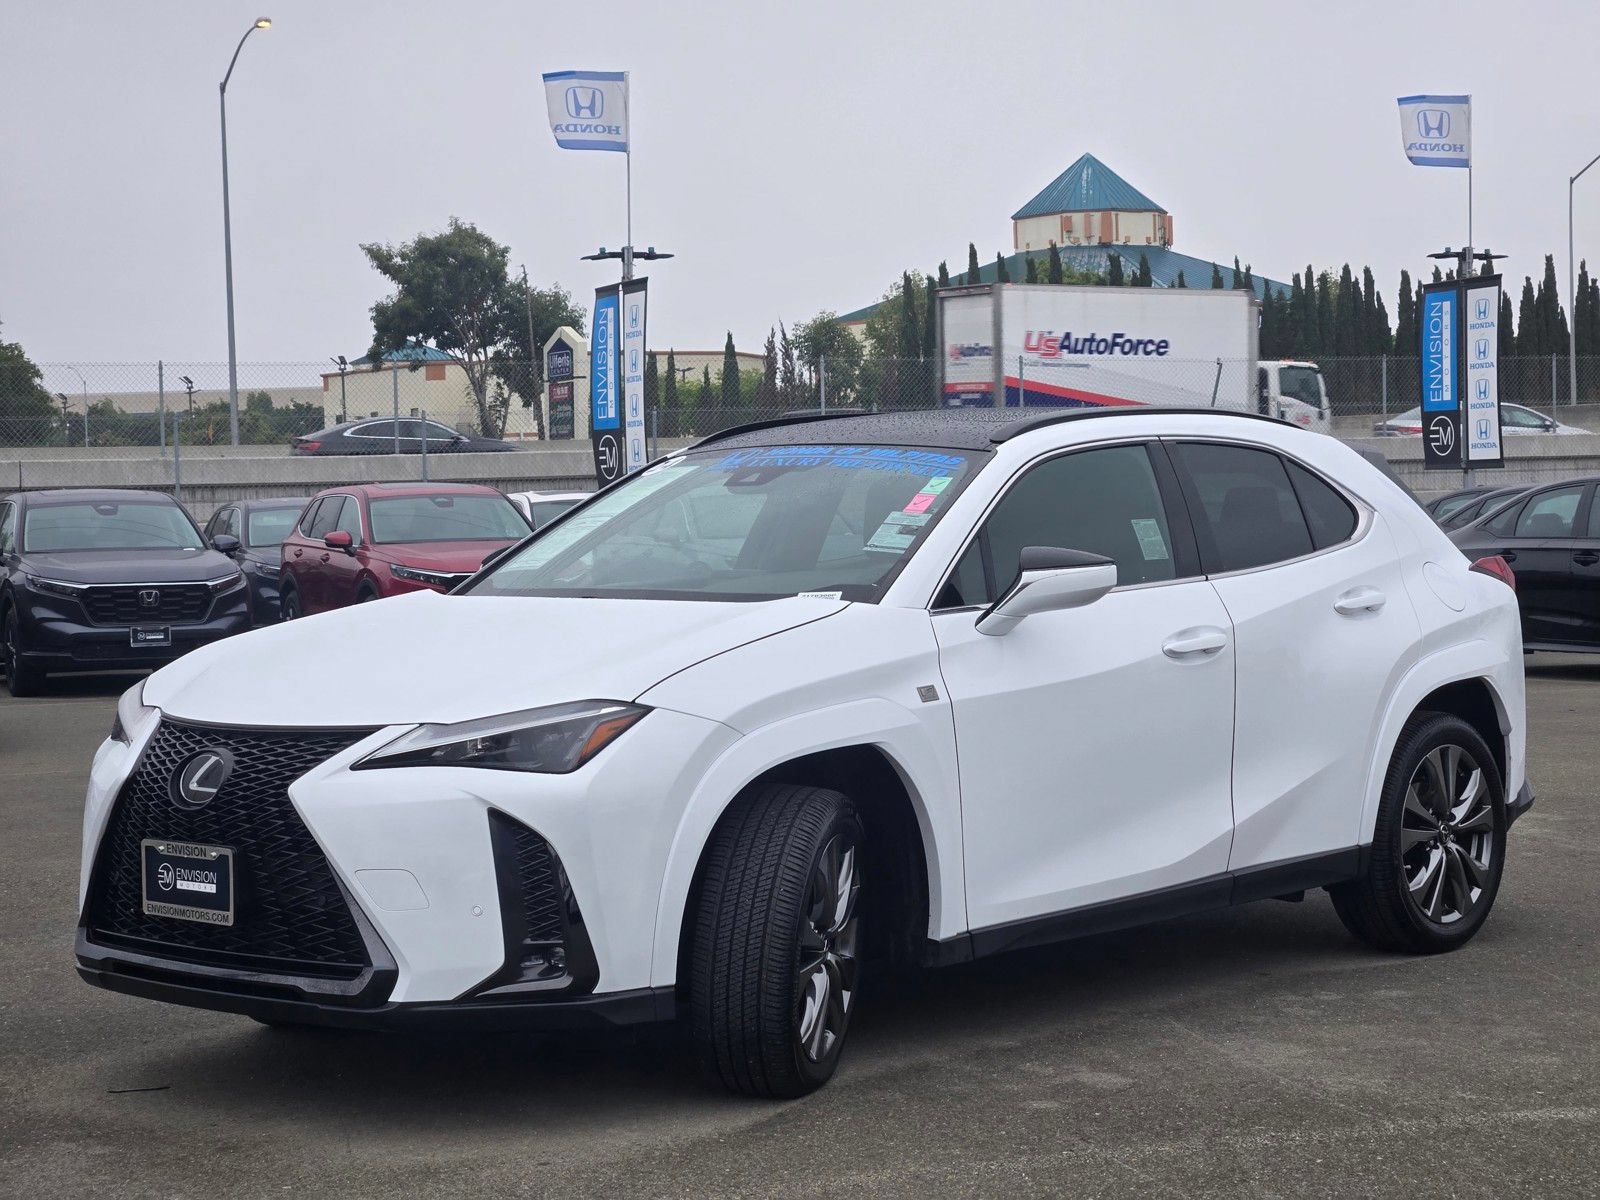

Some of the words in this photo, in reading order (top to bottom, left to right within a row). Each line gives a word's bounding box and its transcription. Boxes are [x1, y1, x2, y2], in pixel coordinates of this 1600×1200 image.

[1469, 322, 1495, 330] HONDA
[626, 330, 642, 339] HONDA
[1430, 302, 1442, 401] ENVISION
[597, 307, 608, 419] ENVISION
[626, 375, 641, 383] HONDA
[166, 843, 207, 858] ENVISION
[176, 867, 217, 884] ENVISION
[146, 903, 230, 924] ENVISIONMOTORS.COM
